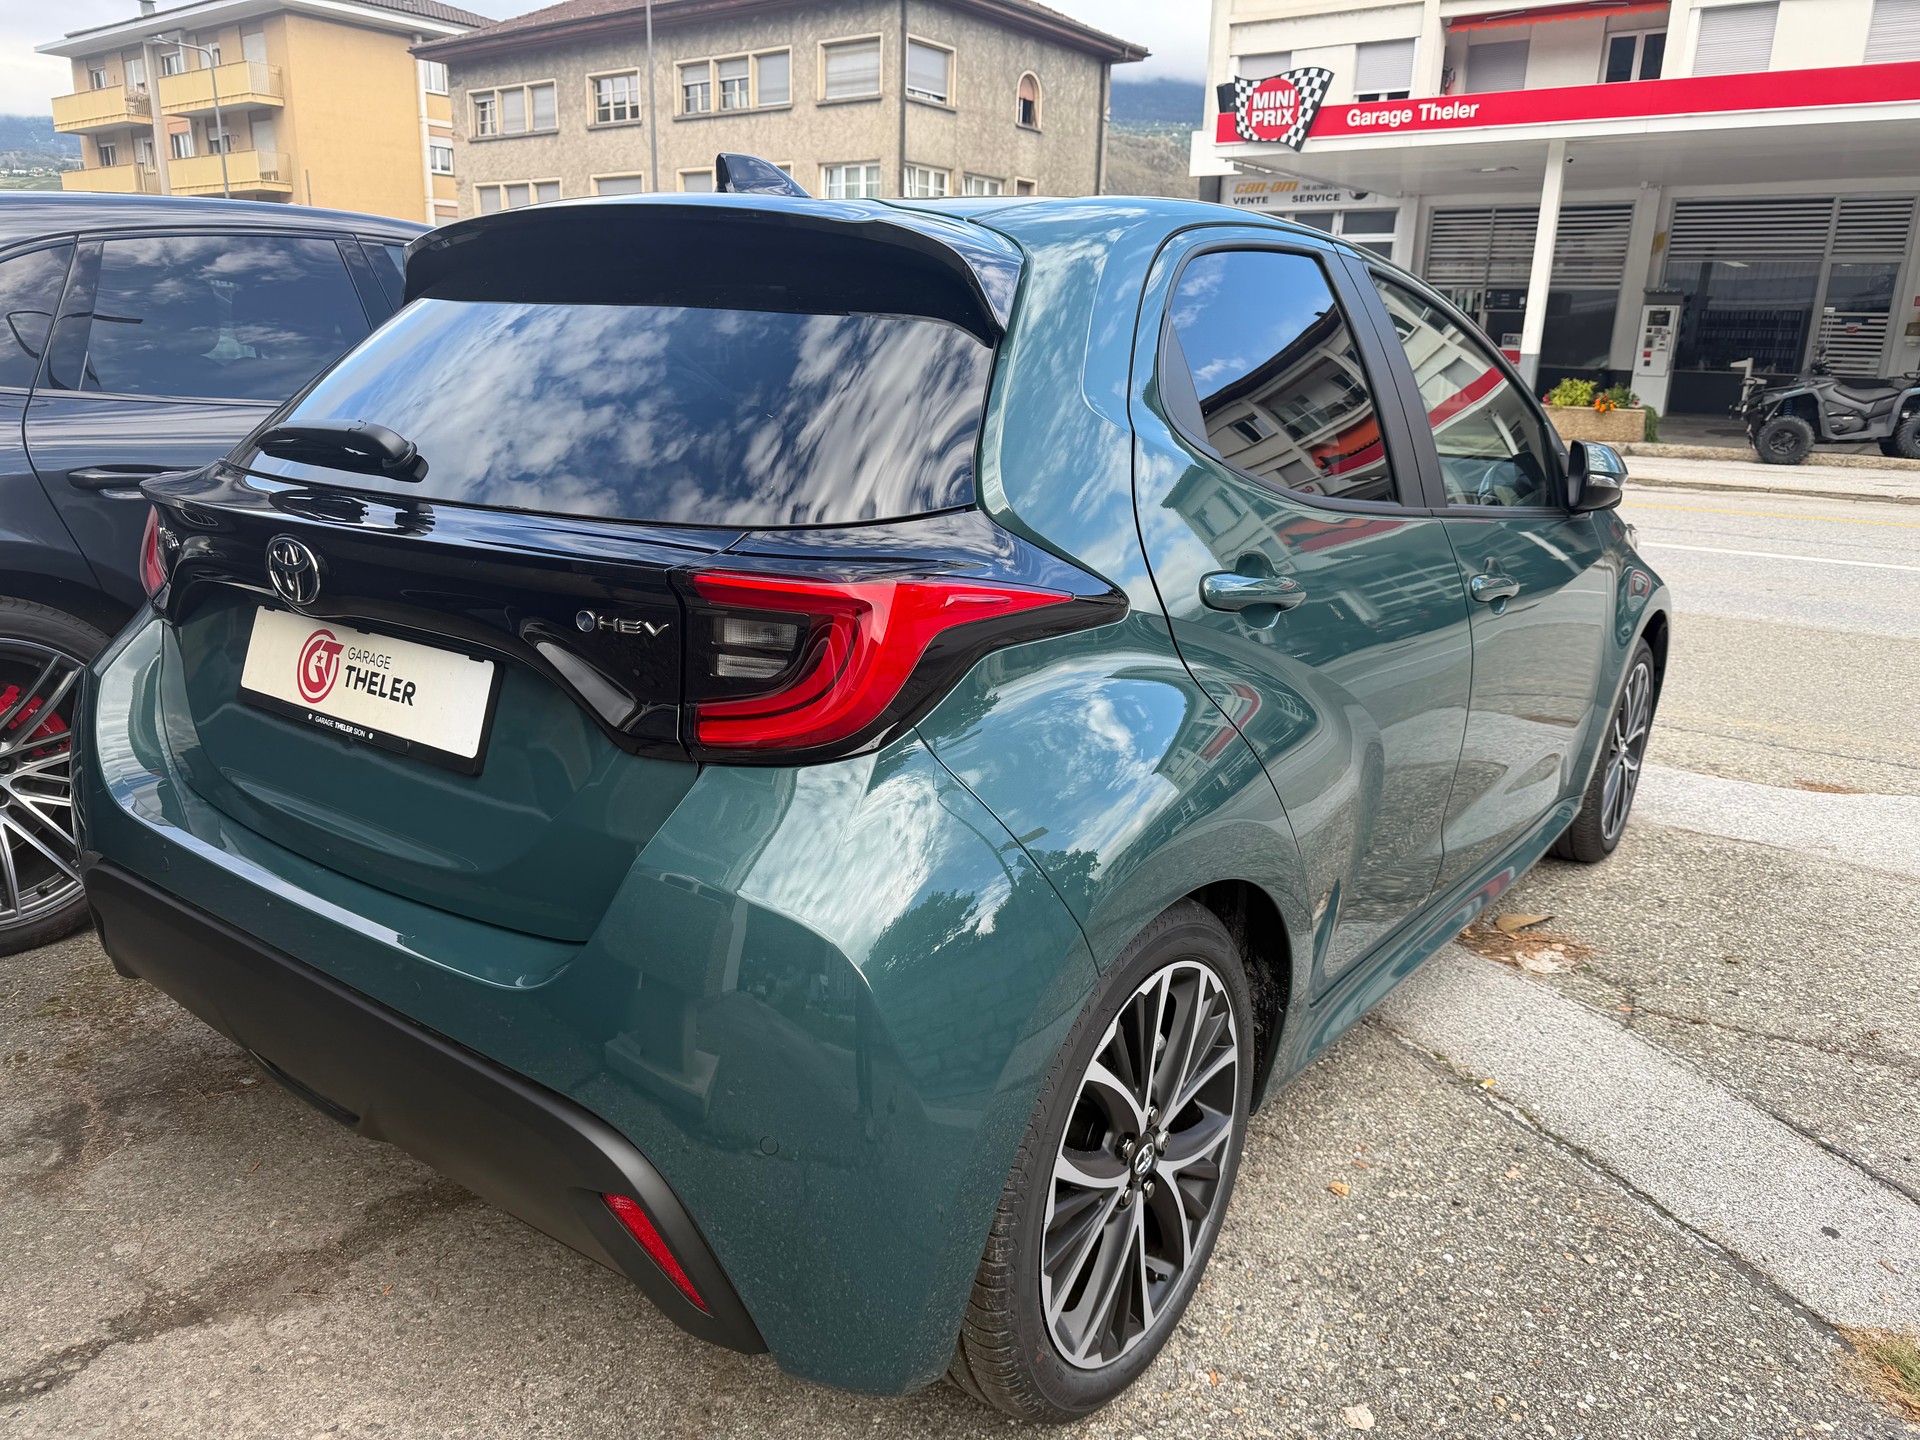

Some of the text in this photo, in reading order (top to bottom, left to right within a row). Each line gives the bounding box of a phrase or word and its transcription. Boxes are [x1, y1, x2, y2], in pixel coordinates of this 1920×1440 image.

[1252, 90, 1295, 109] MINI
[1251, 108, 1295, 127] PRIX
[1347, 101, 1480, 127] Garage Theler
[1233, 192, 1341, 205] VENTE SERVICE
[597, 615, 670, 637] HEV
[347, 646, 392, 670] GARAGE
[345, 664, 417, 707] THELER
[314, 715, 366, 738] GARAGE THELER SION
